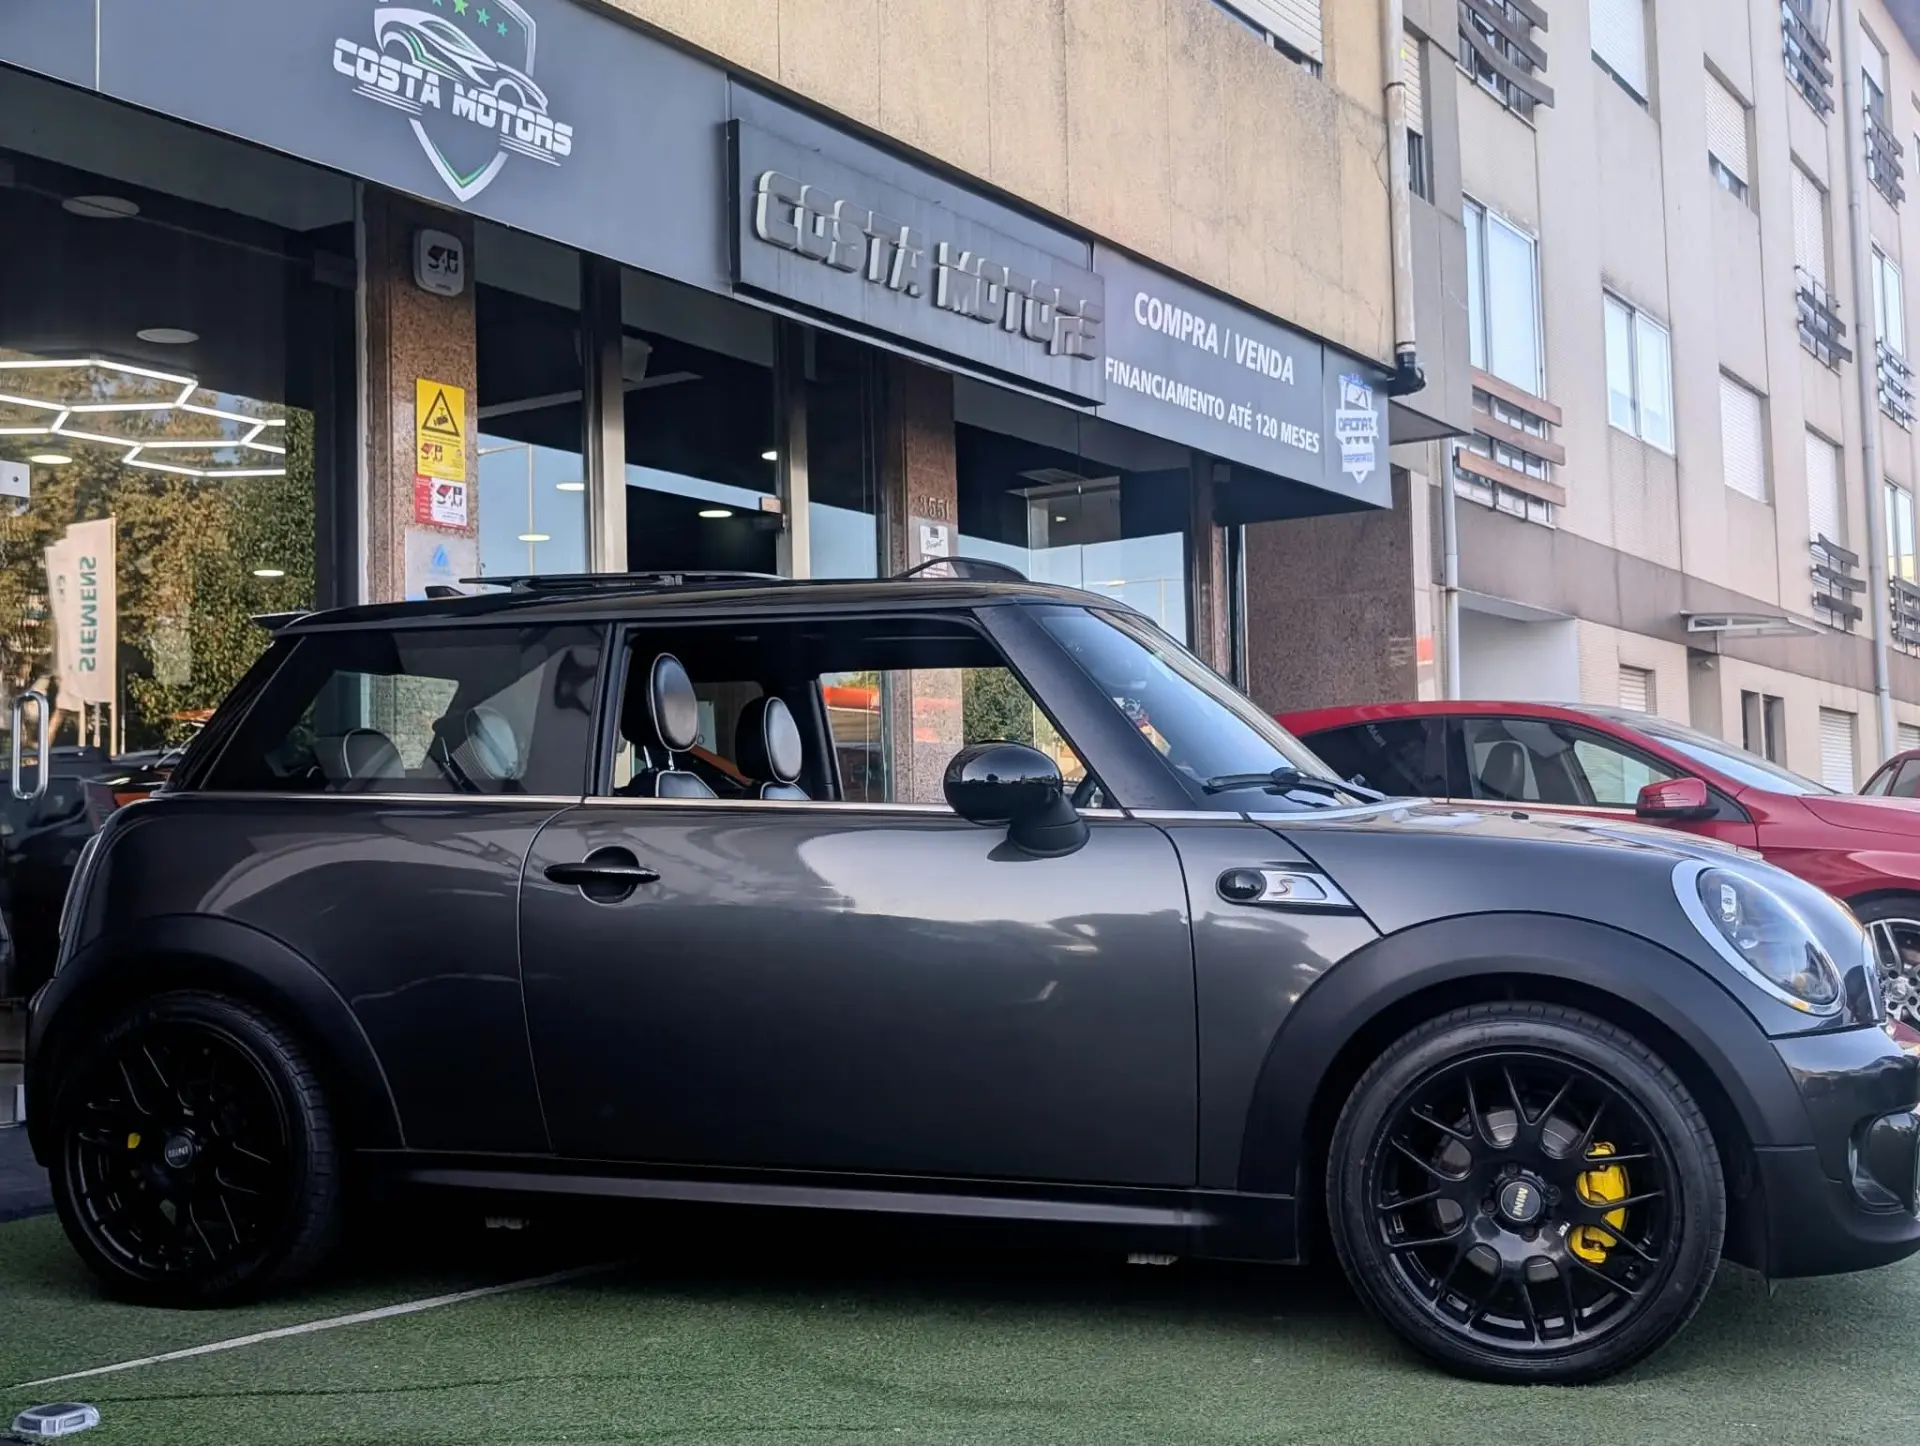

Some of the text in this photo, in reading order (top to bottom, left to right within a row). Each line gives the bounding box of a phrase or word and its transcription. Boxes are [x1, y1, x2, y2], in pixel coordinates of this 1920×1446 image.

[332, 37, 574, 157] COSTA MOTORS
[756, 170, 923, 299] COSTA
[1134, 291, 1219, 355] COMPRA
[1235, 332, 1295, 386] VENDA
[1104, 355, 1225, 421] FINANCIAMENTO
[1228, 402, 1253, 431] ATÉ
[1255, 413, 1278, 440] 120
[1280, 421, 1320, 454] MESES
[1268, 878, 1296, 897] S
[1512, 1187, 1529, 1216] MINI
